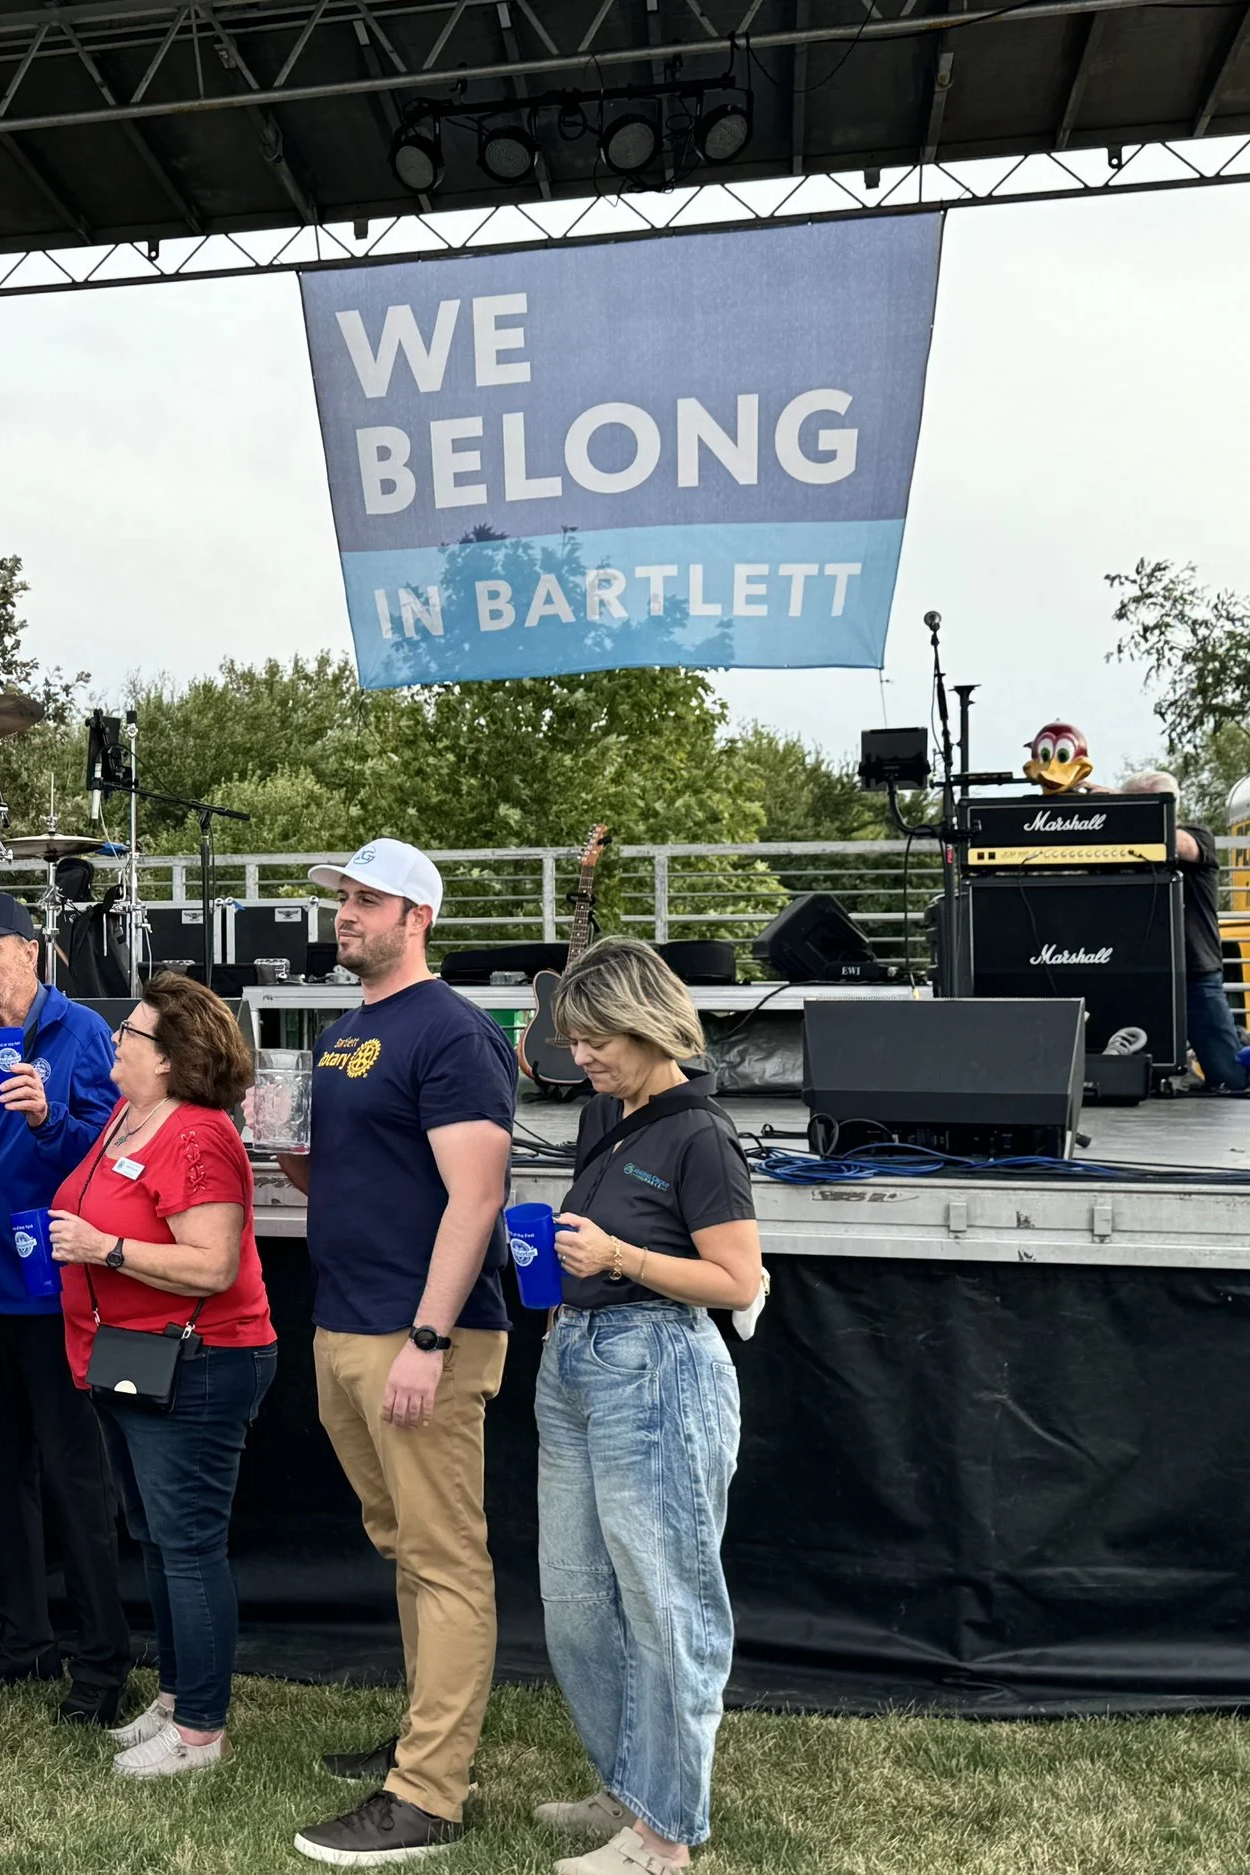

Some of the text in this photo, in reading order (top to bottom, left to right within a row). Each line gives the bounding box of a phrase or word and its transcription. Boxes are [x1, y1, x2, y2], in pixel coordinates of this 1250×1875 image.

[335, 292, 532, 399] WE
[356, 388, 859, 515] BELONG
[373, 562, 862, 639] IN BARTLETT
[1023, 810, 1107, 832] Marshall
[841, 966, 861, 976] EWI
[1029, 943, 1114, 965] Marshall
